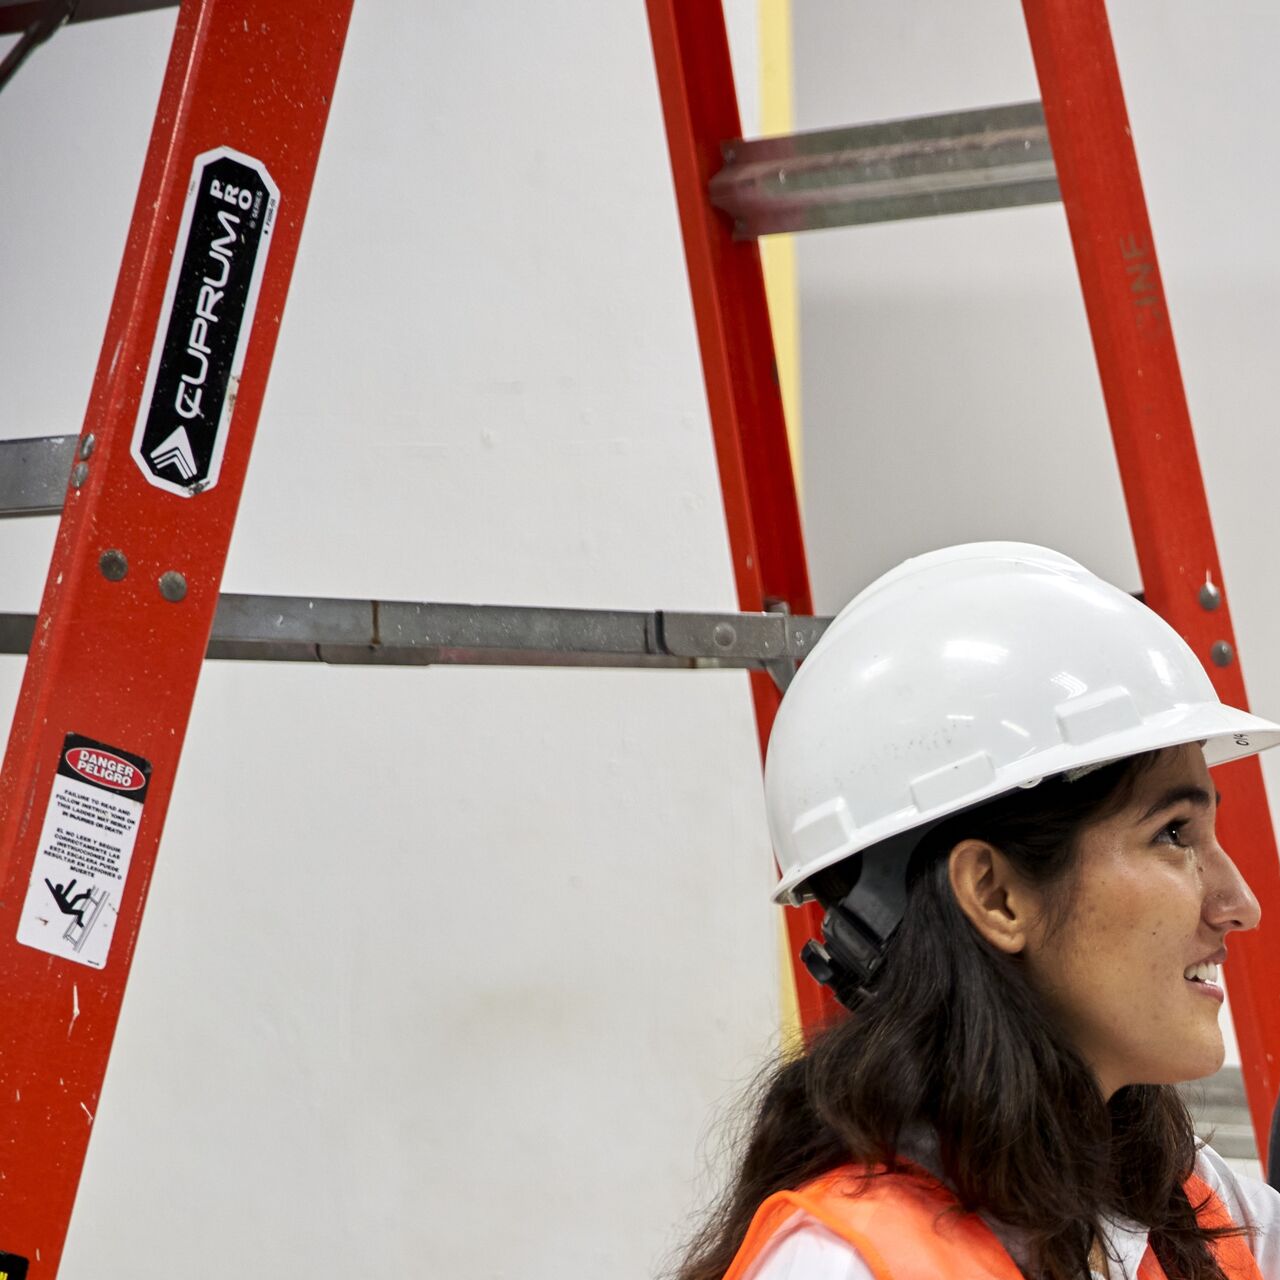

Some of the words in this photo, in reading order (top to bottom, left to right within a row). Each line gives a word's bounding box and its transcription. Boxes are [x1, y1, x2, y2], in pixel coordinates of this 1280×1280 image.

[174, 210, 241, 419] CUPRUM
[209, 179, 253, 211] PRO
[77, 760, 132, 787] PELIGRO
[79, 750, 134, 777] DANGER
[56, 794, 80, 805] FOLLOW
[82, 803, 126, 821] INSTRUCIONS
[57, 801, 71, 810] THIS
[72, 806, 95, 818] LADDER
[110, 819, 131, 831] RESULT
[64, 789, 90, 801] FAILURE
[100, 802, 117, 811] READ
[118, 808, 131, 816] AND
[43, 850, 76, 864] RESULTAR
[54, 833, 107, 855] CORRECTAMENTE
[108, 851, 121, 860] LAS
[56, 841, 106, 862] INSTRUCCIONES
[76, 834, 92, 843] LEER
[99, 840, 121, 853] SEGUIR
[49, 845, 66, 855] ESTA
[67, 850, 98, 866] ESCALERA
[99, 862, 120, 873] PUEDE
[70, 865, 95, 878] MUERTE
